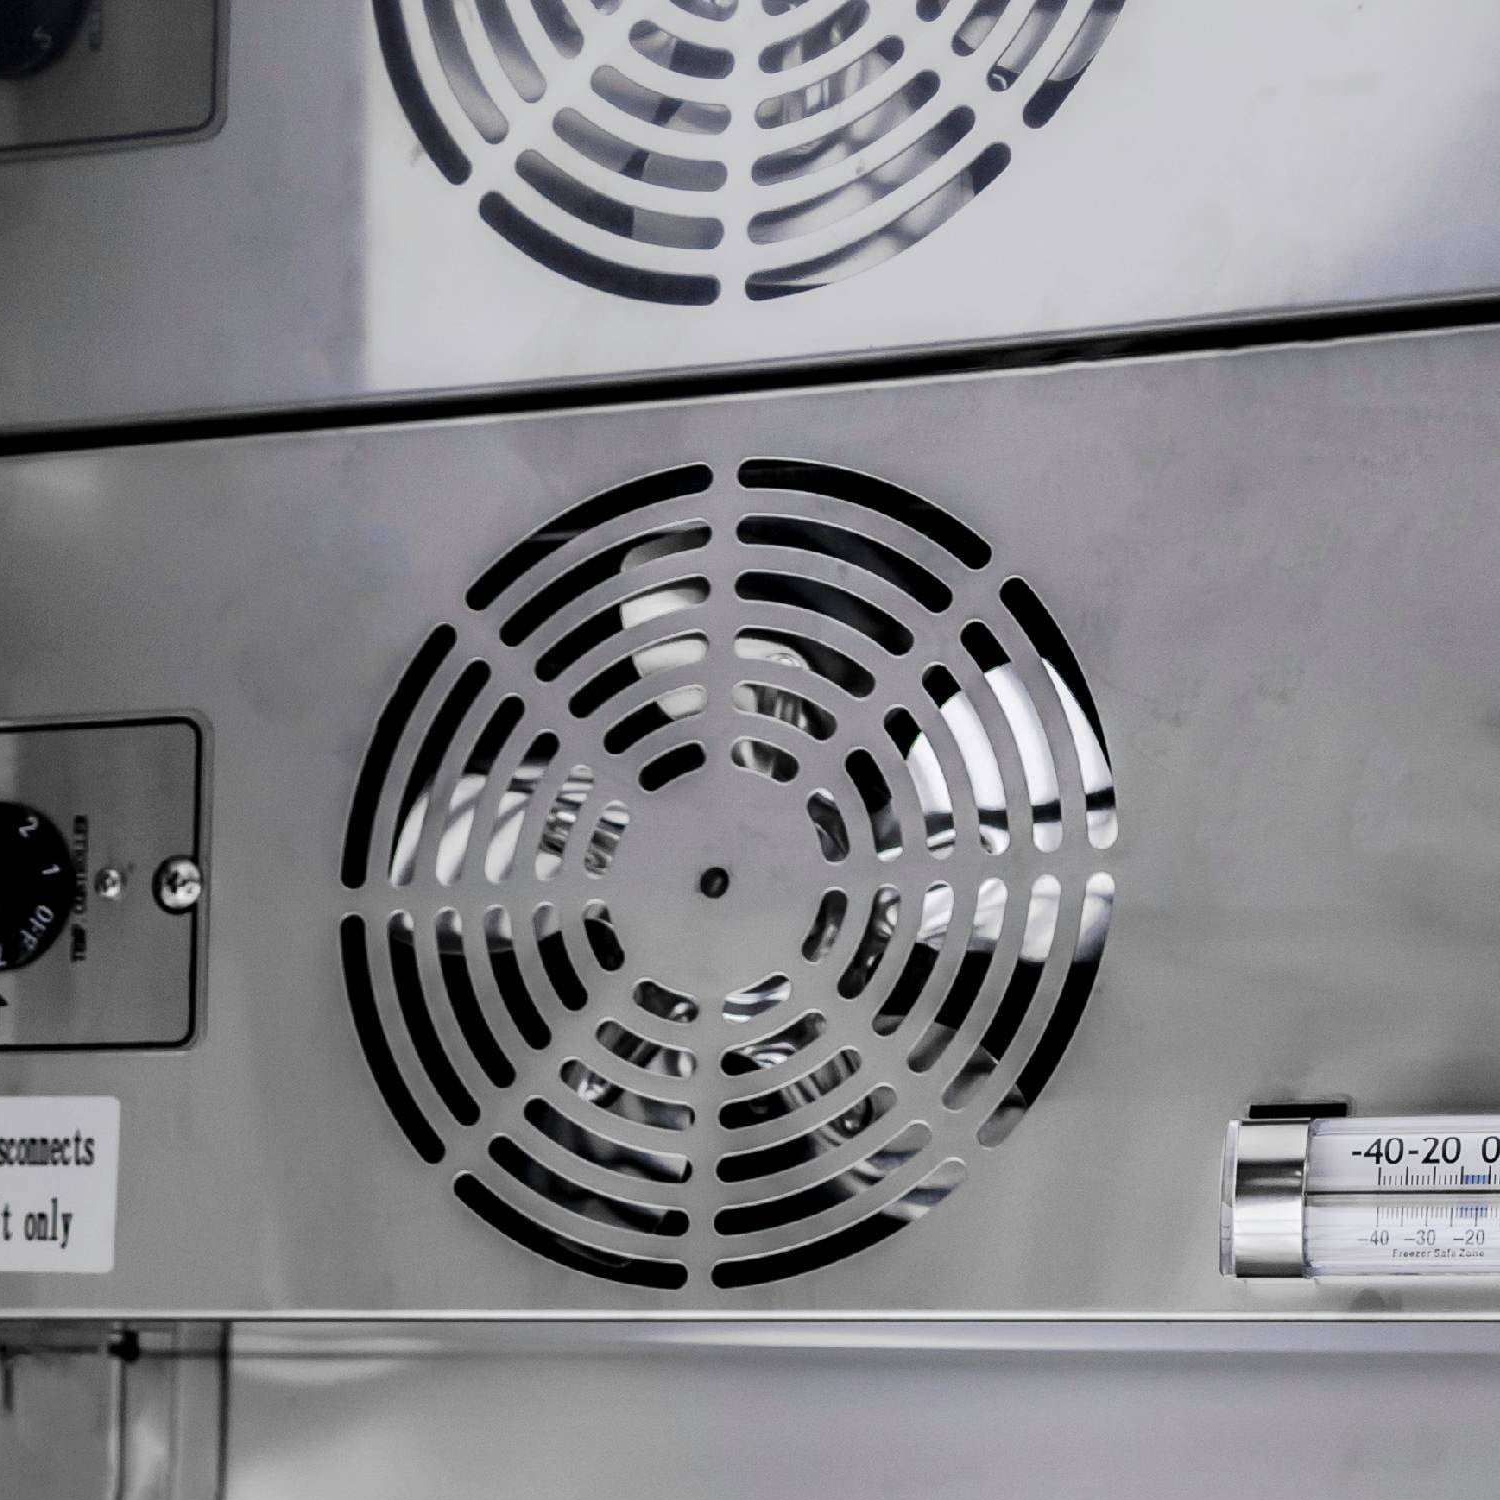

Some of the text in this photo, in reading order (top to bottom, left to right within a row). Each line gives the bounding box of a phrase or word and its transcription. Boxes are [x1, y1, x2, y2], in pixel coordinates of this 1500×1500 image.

[18, 816, 39, 838] 2
[1351, 1136, 1404, 1165] -40
[1408, 1136, 1462, 1164] -20
[24, 1197, 73, 1249] only
[1357, 1228, 1486, 1246] -40 -30 -20
[1392, 1248, 1485, 1259] Freezer Safe Zone
